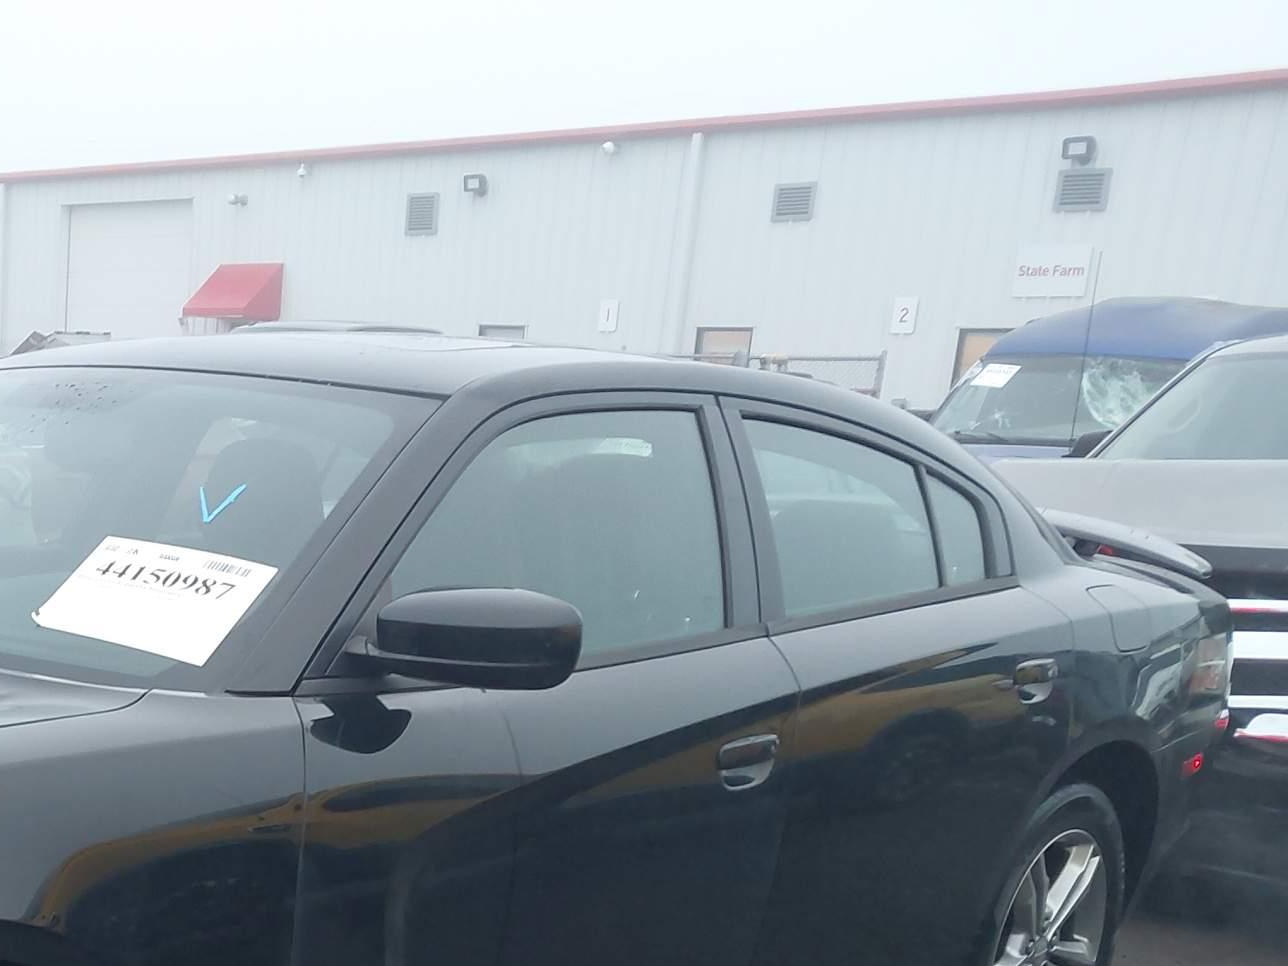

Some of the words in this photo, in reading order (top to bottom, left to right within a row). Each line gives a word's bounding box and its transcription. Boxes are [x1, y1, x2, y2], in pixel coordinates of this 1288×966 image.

[1017, 264, 1050, 277] State
[1052, 264, 1085, 277] Farm
[898, 307, 910, 323] 2
[96, 560, 237, 600] 44150987
